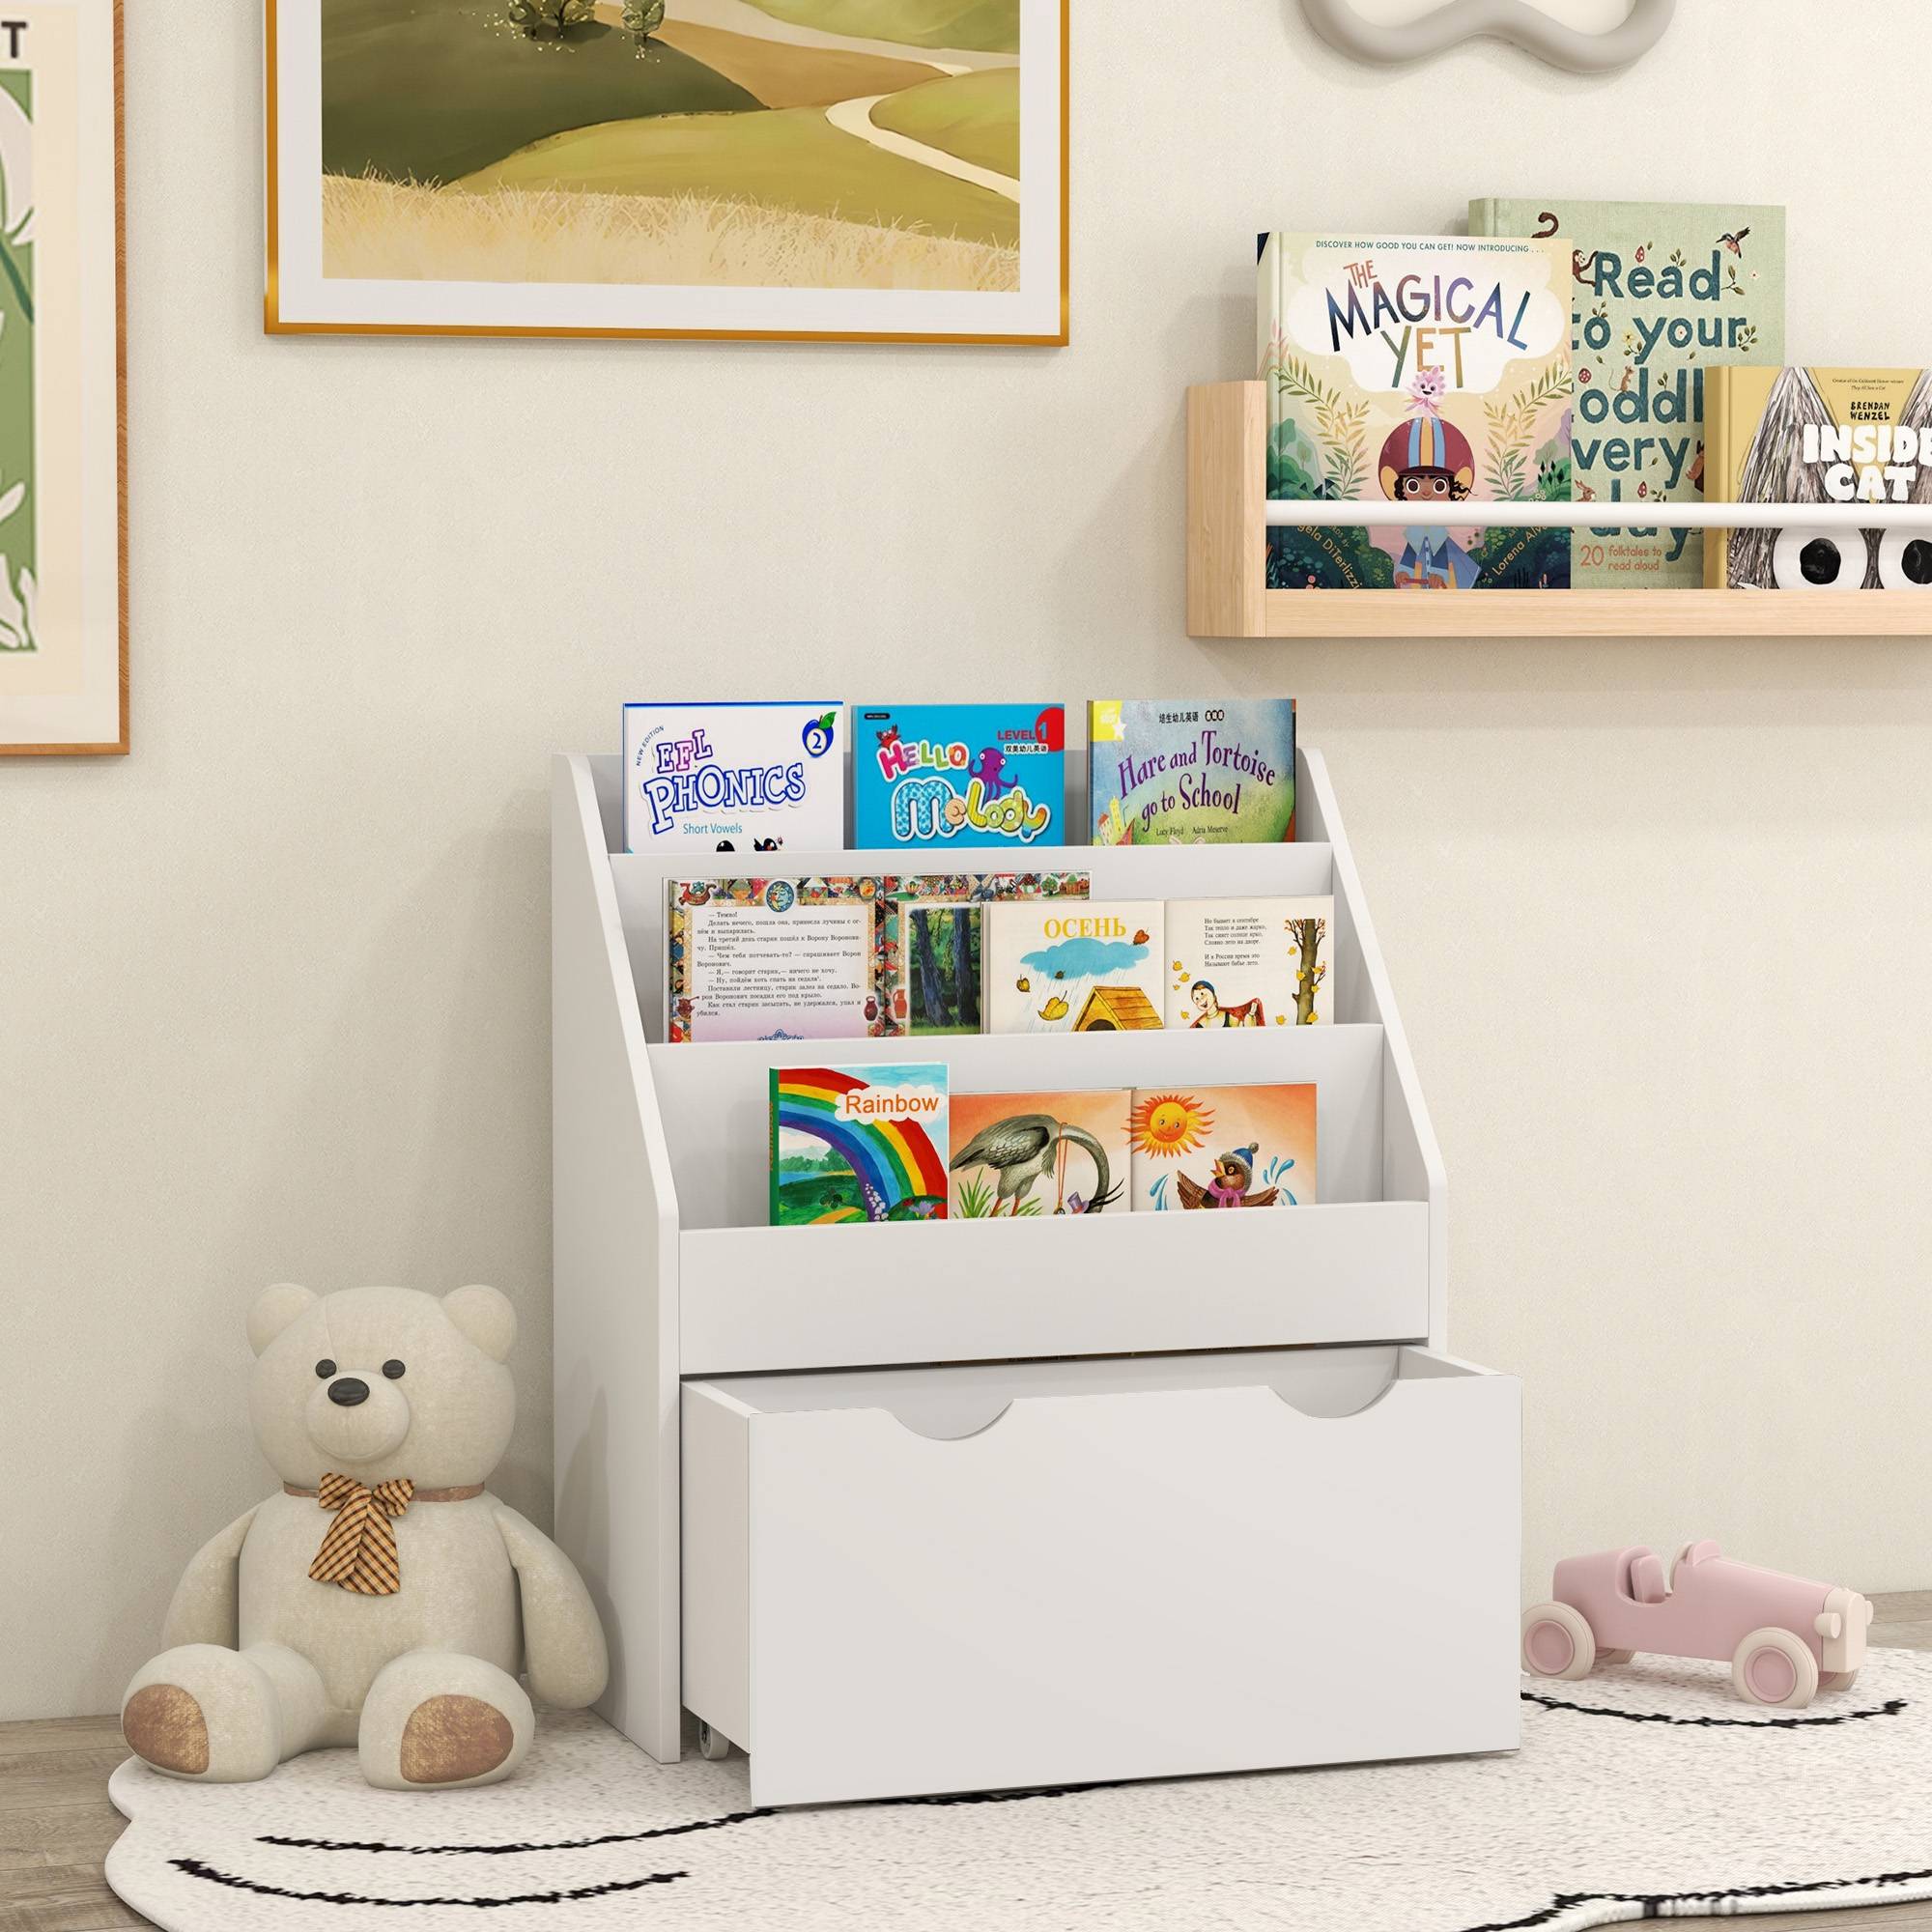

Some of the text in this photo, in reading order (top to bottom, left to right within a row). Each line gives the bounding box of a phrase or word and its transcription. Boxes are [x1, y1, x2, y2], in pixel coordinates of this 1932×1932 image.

[1354, 241, 1374, 249] HOW
[1402, 242, 1417, 250] YOU
[1343, 260, 1378, 289] THE
[1594, 249, 1721, 301] Read
[1325, 273, 1531, 353] MAGICAL
[1380, 326, 1471, 388] YET
[1633, 316, 1747, 365] your
[1572, 367, 1703, 424] oddl
[1851, 401, 1890, 411] BRENDAN
[1850, 411, 1890, 421] WENZEL
[1572, 438, 1690, 490] very
[1824, 463, 1917, 501] CAT
[1492, 541, 1525, 576] Lorena
[1580, 545, 1605, 566] 20
[1608, 545, 1662, 557] folktales to
[1608, 559, 1660, 571] read aloud
[636, 725, 665, 766] NEW EDITION
[812, 731, 822, 750] 2
[997, 722, 1048, 741] LEVEL 1
[656, 728, 714, 774] EFL
[878, 741, 968, 780] HELLO
[1118, 730, 1275, 800] Hare and Tortoise
[643, 762, 806, 835] PHONICS
[1142, 773, 1241, 833] go to School
[683, 823, 743, 835] Short Vowels
[1043, 917, 1126, 939] ОСЕНЬ
[845, 1094, 939, 1114] Rainbow
